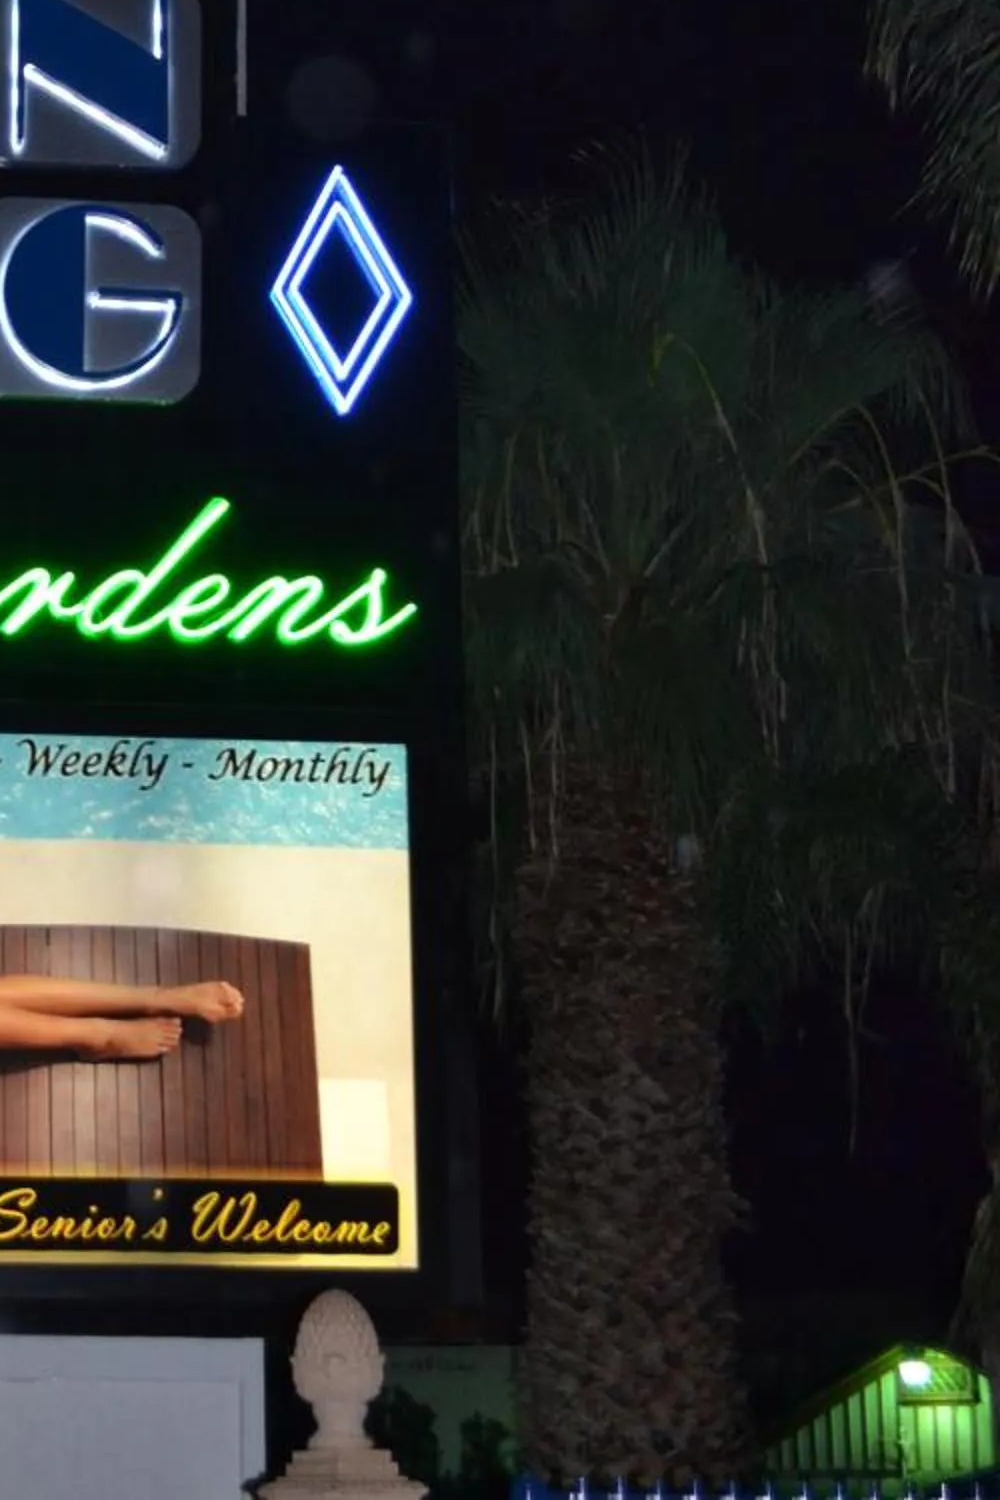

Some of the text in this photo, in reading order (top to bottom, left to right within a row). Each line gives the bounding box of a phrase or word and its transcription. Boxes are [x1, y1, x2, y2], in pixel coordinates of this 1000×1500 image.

[17, 738, 170, 791] Weekly
[207, 748, 392, 797] Monthly
[191, 1190, 392, 1245] Welcome
